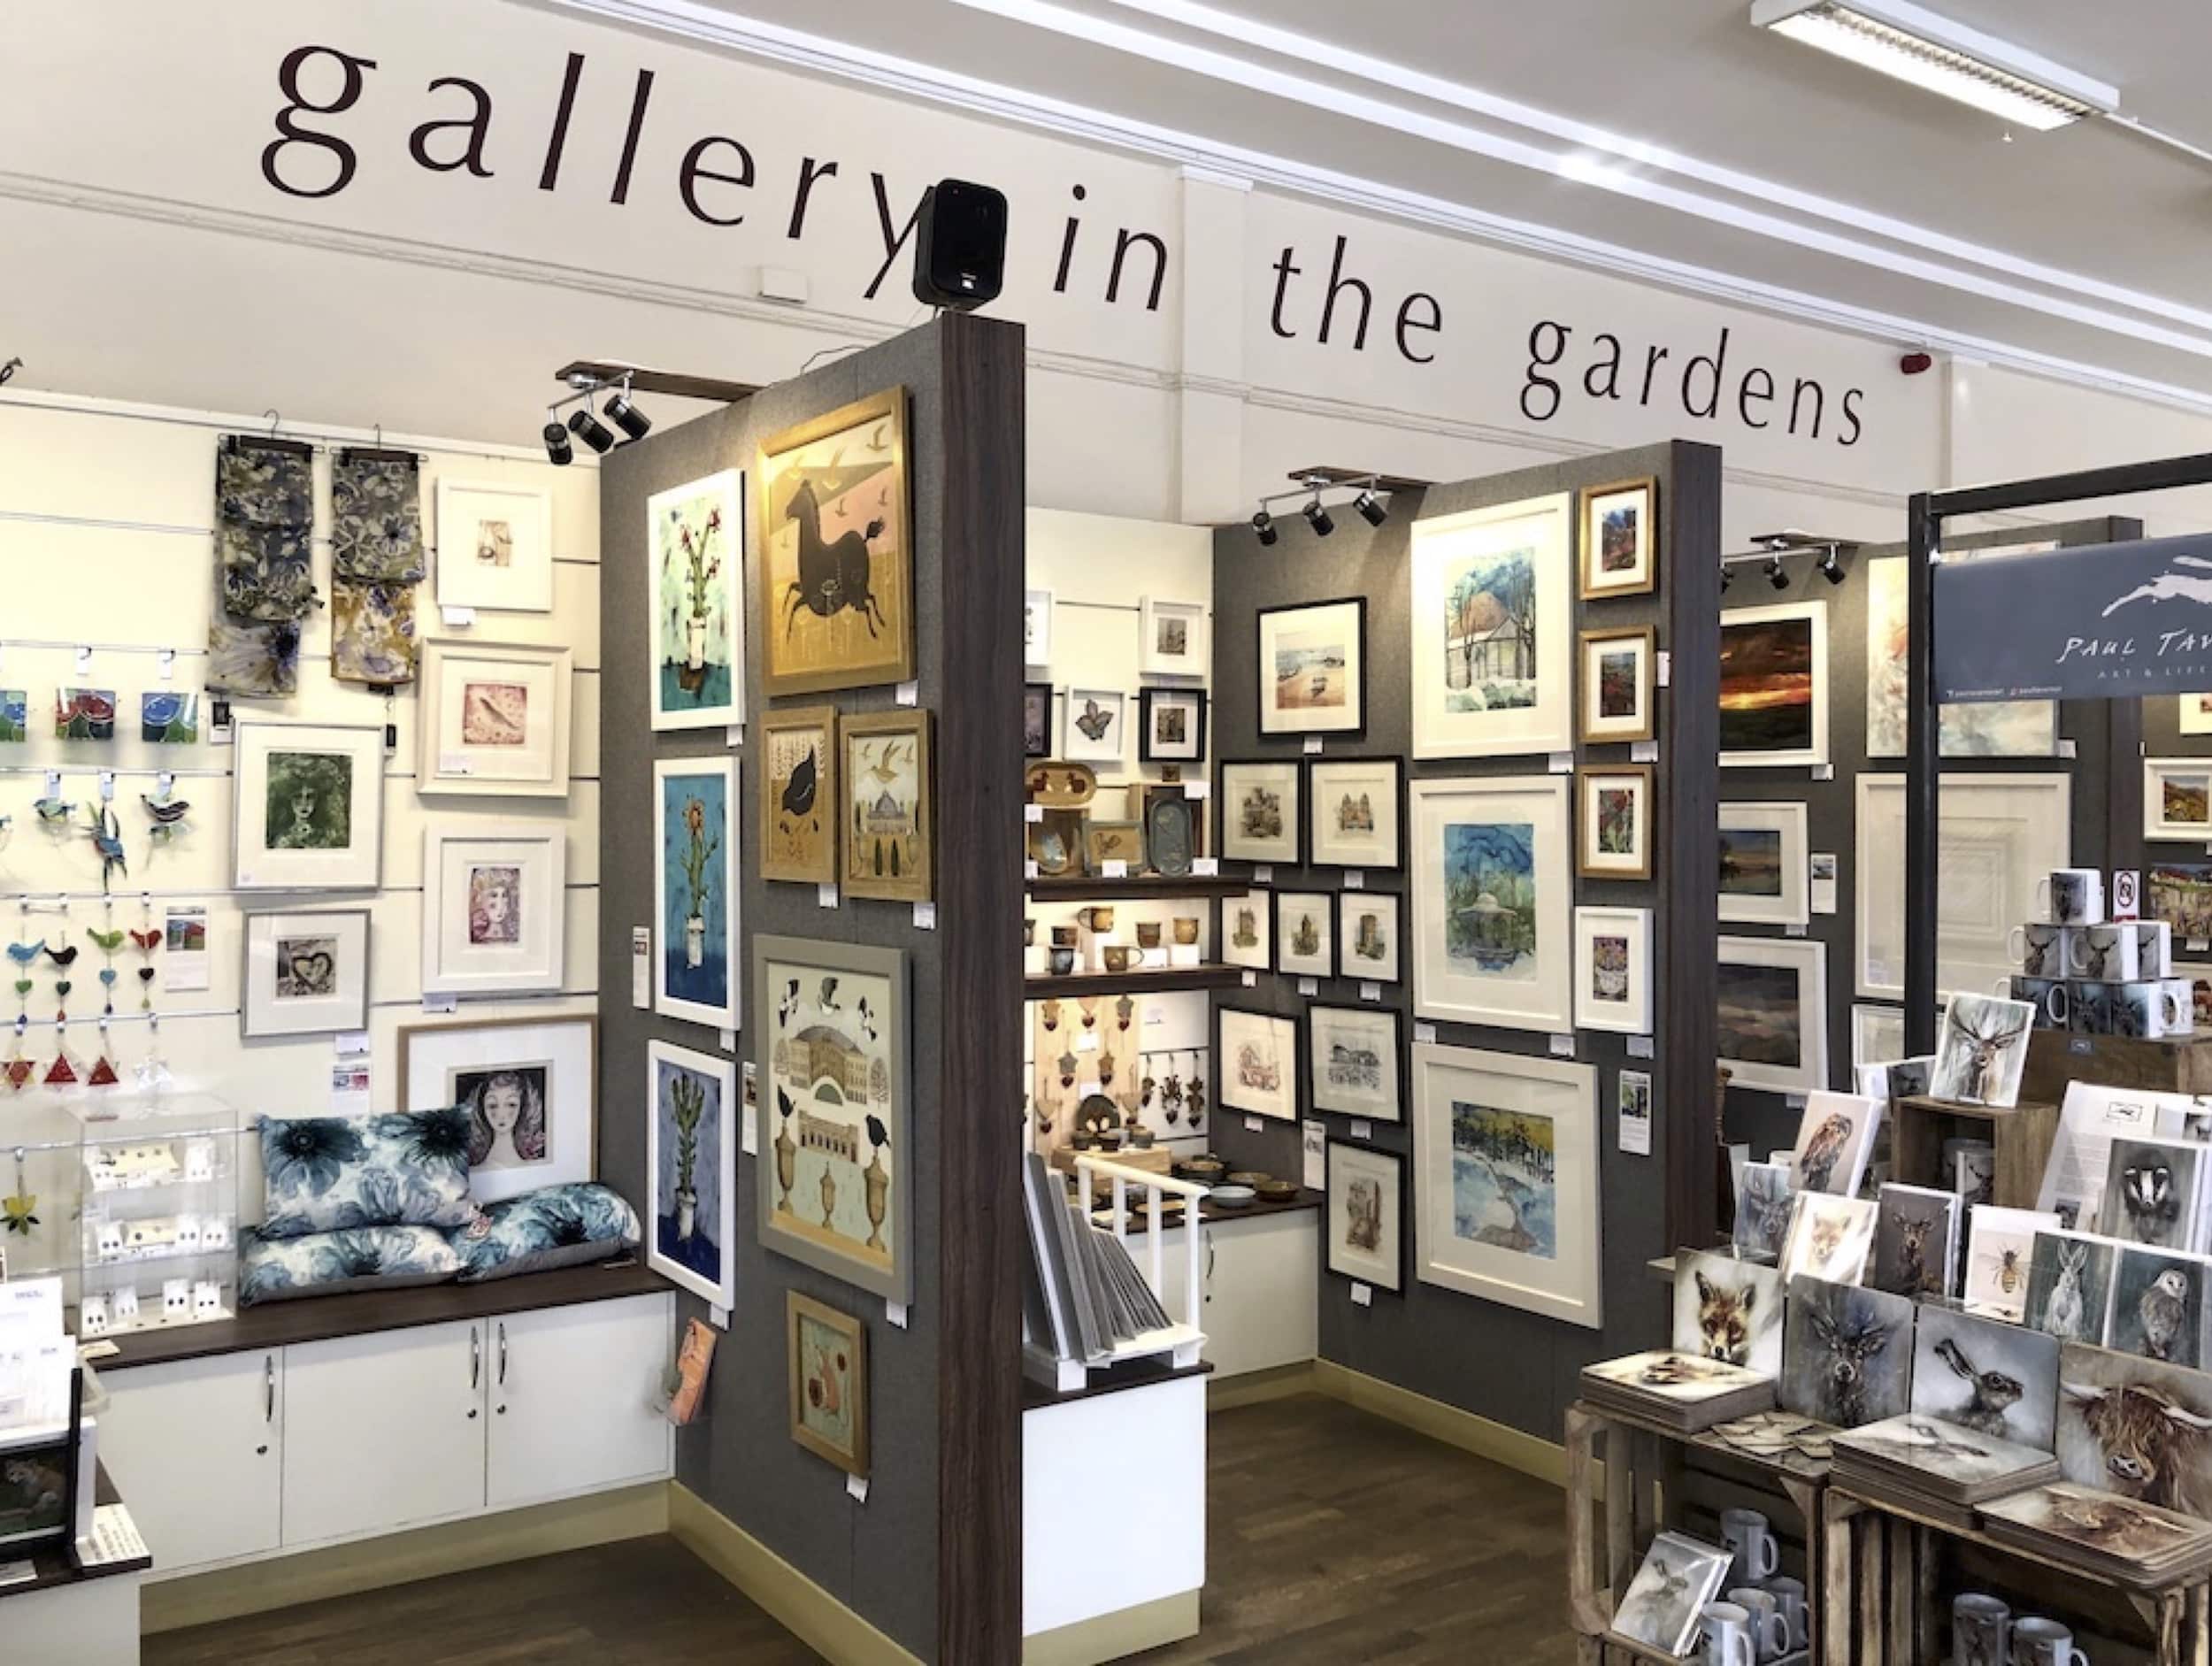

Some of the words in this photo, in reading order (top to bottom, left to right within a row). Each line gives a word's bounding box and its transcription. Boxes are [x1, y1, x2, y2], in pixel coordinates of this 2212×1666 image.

[260, 44, 929, 305] gallery
[1053, 184, 1167, 312] in
[1271, 234, 1441, 364] the
[1519, 321, 1863, 446] gardens
[2055, 637, 2136, 664] PAUL
[2097, 667, 2131, 679] ART
